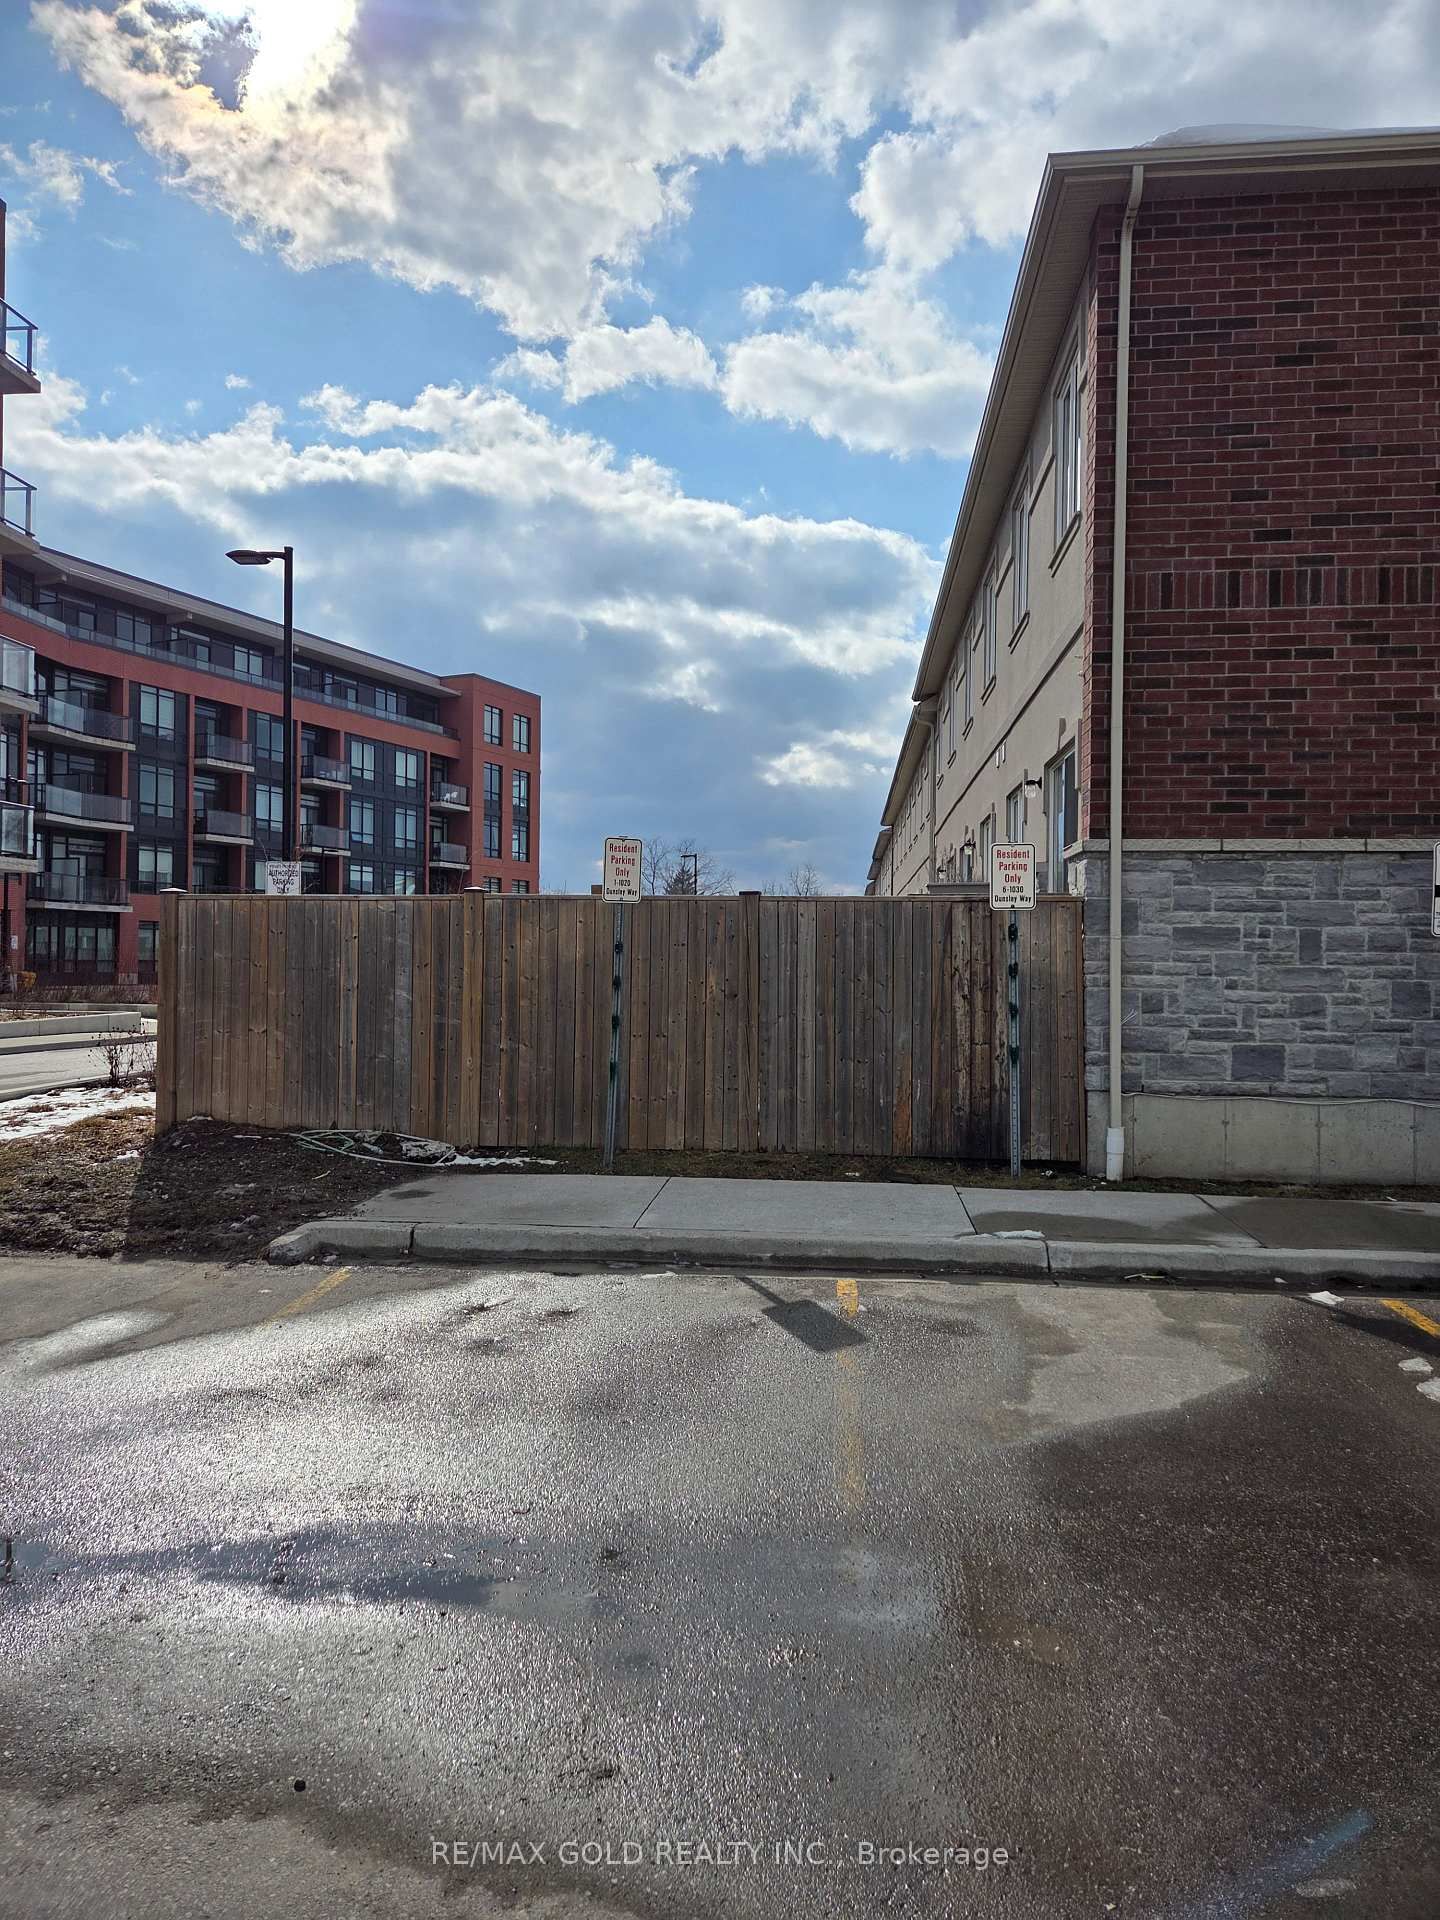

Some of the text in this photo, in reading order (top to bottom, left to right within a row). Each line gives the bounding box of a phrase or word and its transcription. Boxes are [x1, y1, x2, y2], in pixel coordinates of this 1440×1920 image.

[609, 843, 638, 853] Resident
[996, 849, 1030, 859] Resident
[611, 855, 636, 866] Parking
[998, 861, 1028, 872] Parking
[615, 867, 630, 878] Only
[1004, 873, 1022, 884] Only
[627, 888, 637, 896] Way
[1019, 895, 1031, 903] Way
